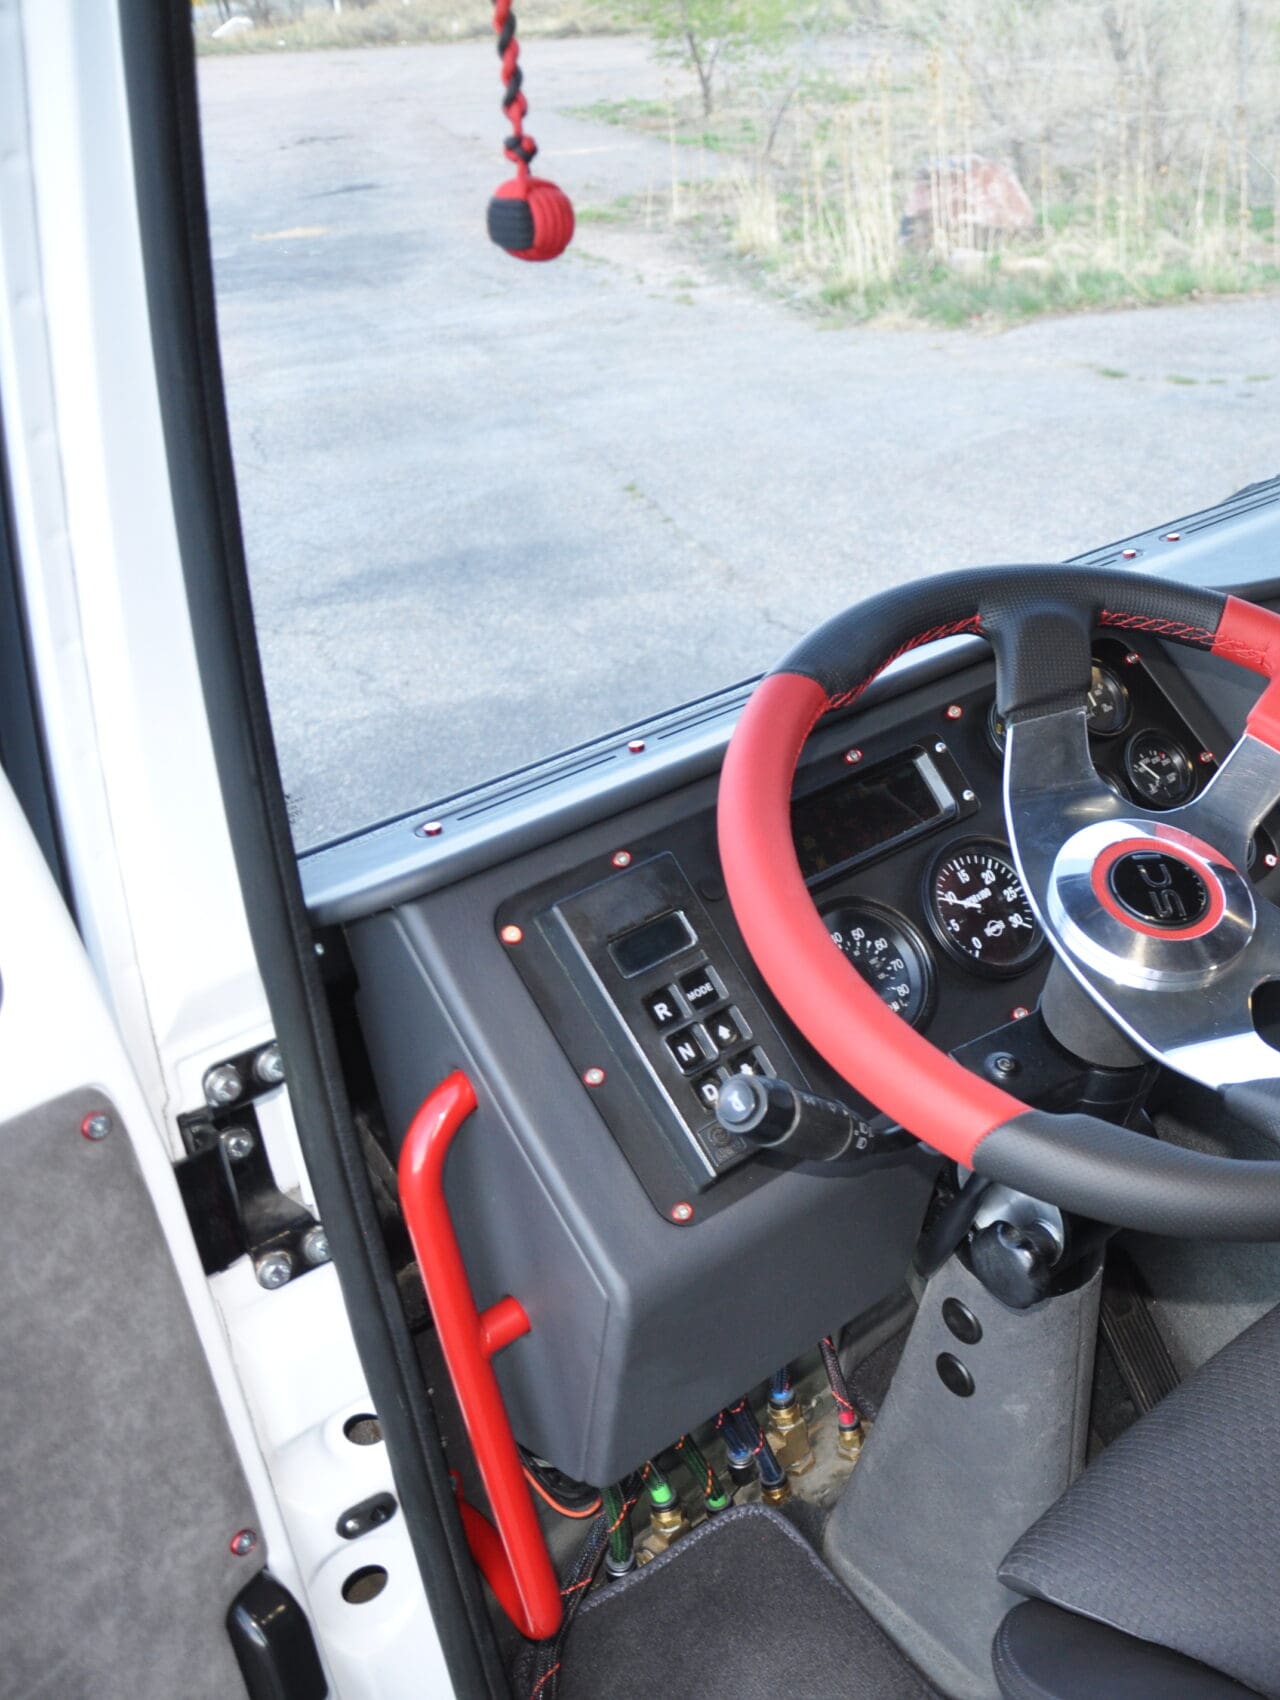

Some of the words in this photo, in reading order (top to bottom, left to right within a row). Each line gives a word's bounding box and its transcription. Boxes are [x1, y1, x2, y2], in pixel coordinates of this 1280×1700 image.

[957, 869, 970, 884] 15
[981, 869, 996, 885] 20
[1003, 886, 1018, 902] 25
[949, 919, 960, 932] 5
[1008, 913, 1023, 928] 30
[851, 927, 865, 941] 50
[971, 937, 983, 949] 0
[890, 958, 904, 971] 70
[686, 982, 714, 1001] MODE
[896, 983, 910, 996] 80
[653, 1002, 673, 1021] R
[677, 1043, 695, 1061] N
[702, 1083, 719, 1101] D
